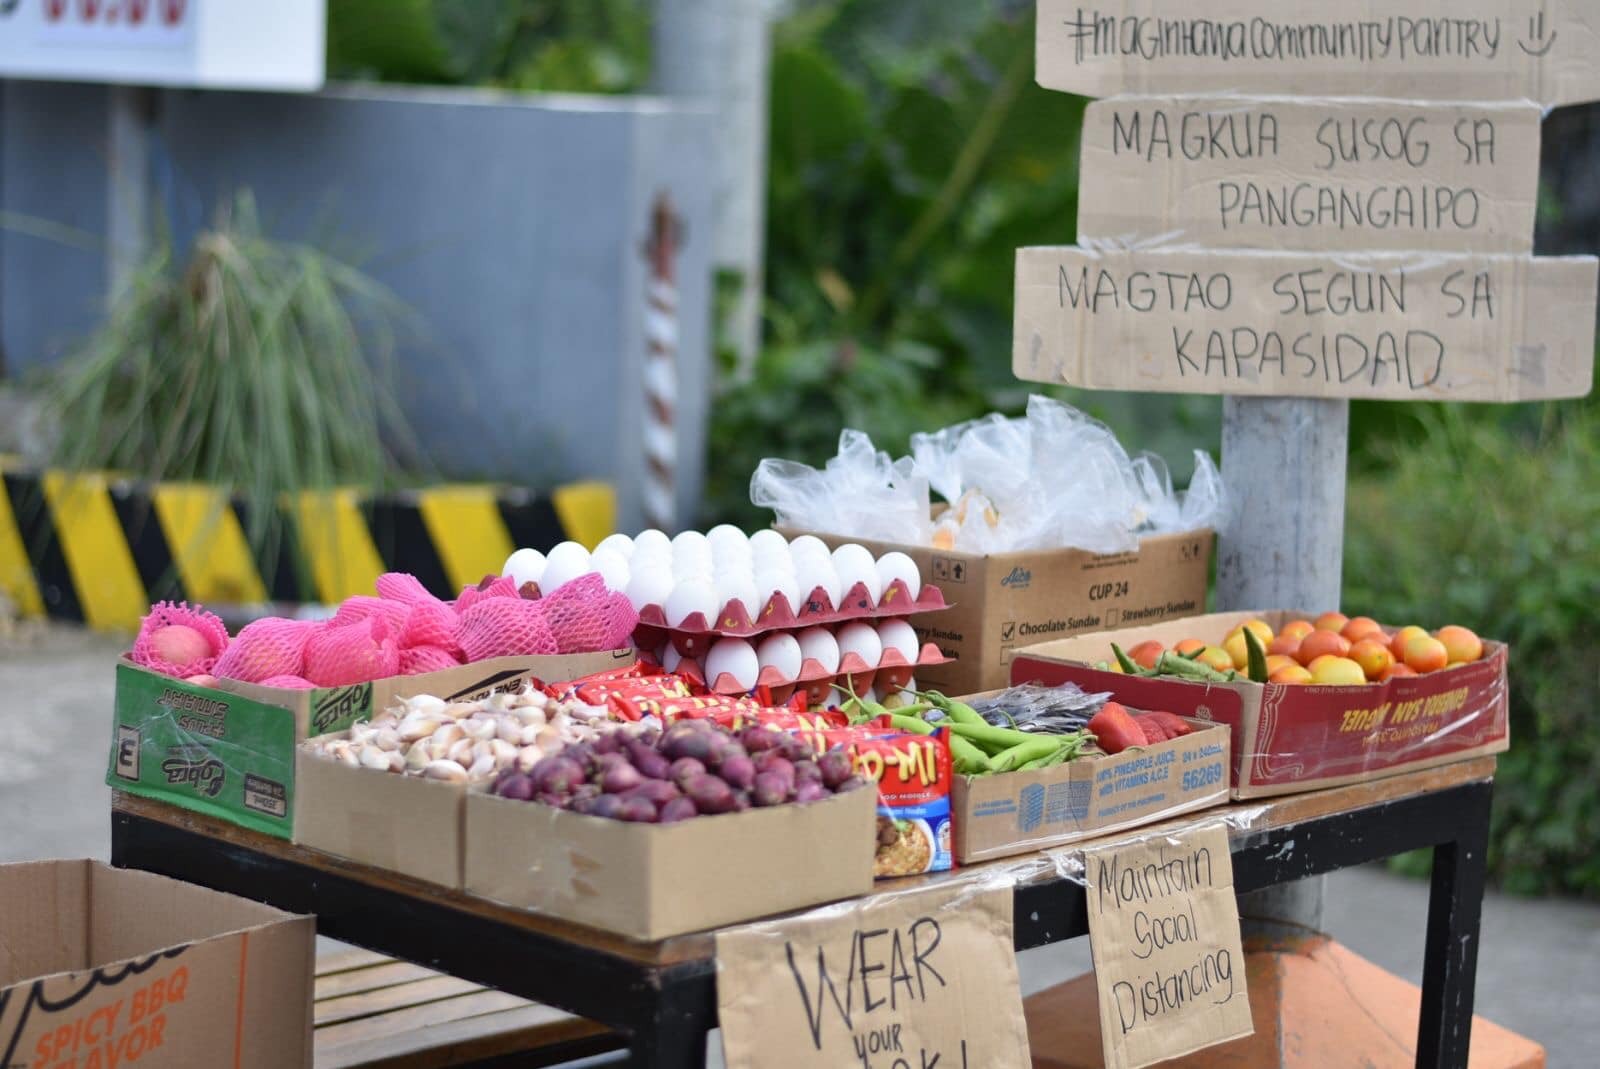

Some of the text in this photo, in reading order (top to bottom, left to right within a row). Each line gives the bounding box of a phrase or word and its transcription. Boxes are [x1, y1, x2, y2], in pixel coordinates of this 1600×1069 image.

[1113, 110, 1496, 170] MAGKUA SUSOG SA
[1058, 263, 1495, 321] MAGTAO SEGUN SA
[1088, 580, 1129, 601] CUP 24
[1018, 614, 1101, 636] Chocolate Sundae
[1121, 599, 1197, 623] Strawberry Sundae
[157, 688, 230, 721] SMART
[1391, 698, 1424, 725] SAN
[161, 757, 226, 797] Cobra
[1114, 756, 1153, 777] PINEAPPLE
[1154, 750, 1175, 766] JUICE
[1115, 771, 1149, 792] VITAMINS
[1182, 762, 1222, 791] 56269
[1098, 846, 1213, 915] Maintain
[1132, 901, 1199, 960] Social
[785, 916, 946, 1051] WEAR
[1112, 947, 1233, 1035] Distancing
[32, 997, 124, 1069] SPICY
[129, 964, 190, 1025] BBQ
